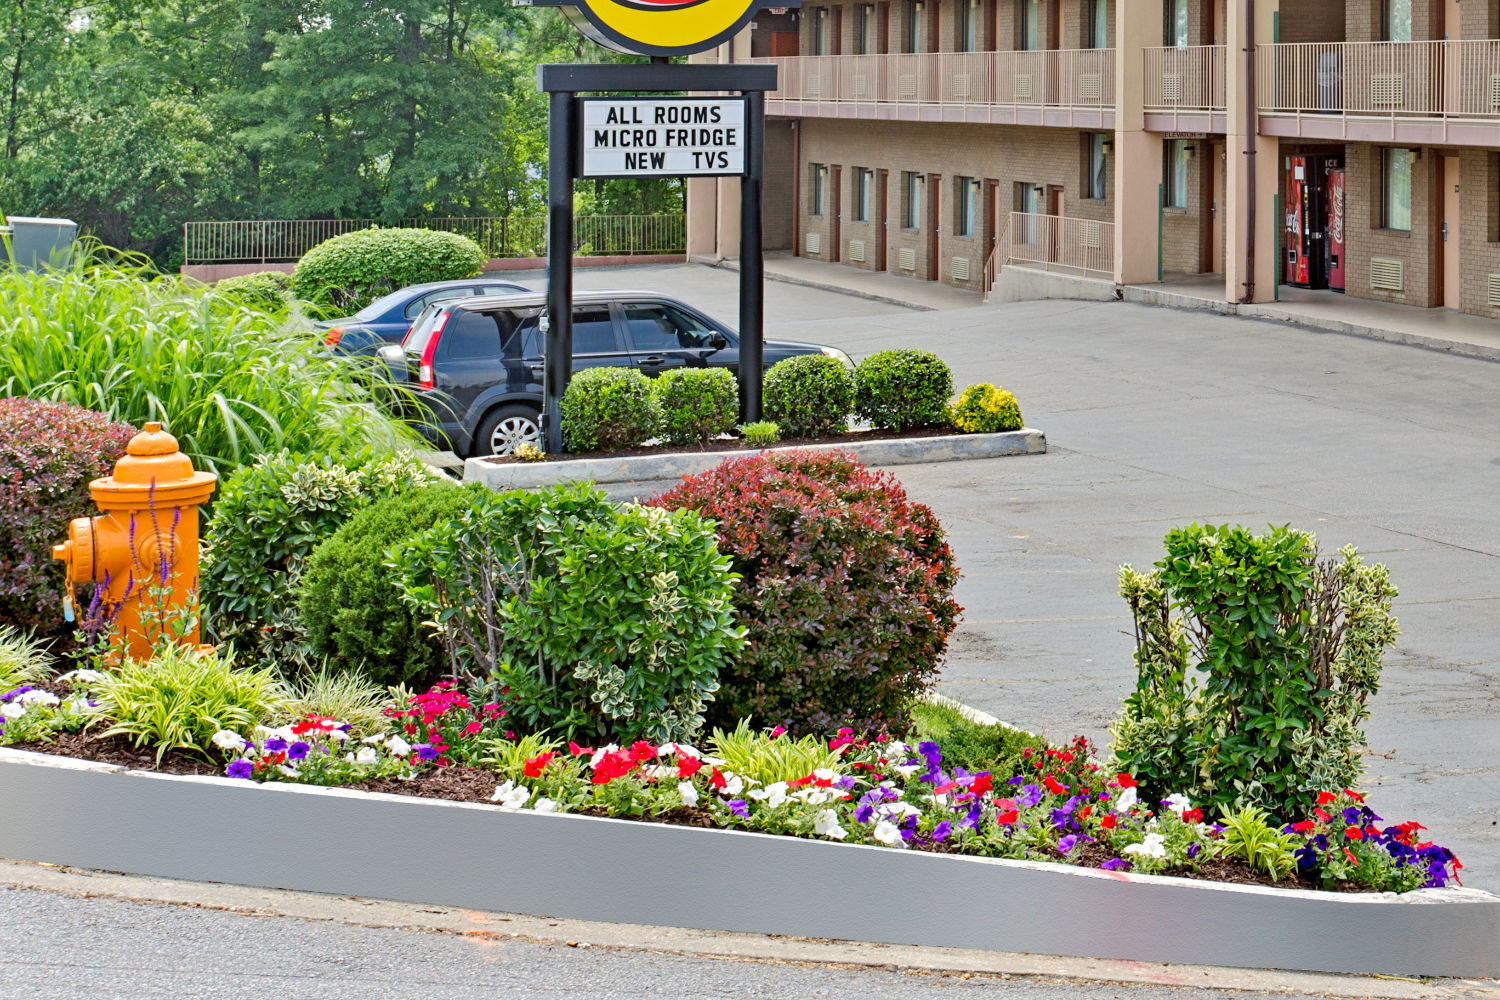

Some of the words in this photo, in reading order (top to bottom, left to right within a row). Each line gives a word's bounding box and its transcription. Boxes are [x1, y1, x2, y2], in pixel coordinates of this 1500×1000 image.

[606, 106, 643, 125] ALL
[654, 106, 721, 124] ROOMS
[594, 129, 657, 148] MICRO
[666, 128, 736, 147] FRIDGE
[625, 152, 665, 170] NEW
[692, 151, 728, 169] TVS
[1324, 159, 1338, 168] ICE
